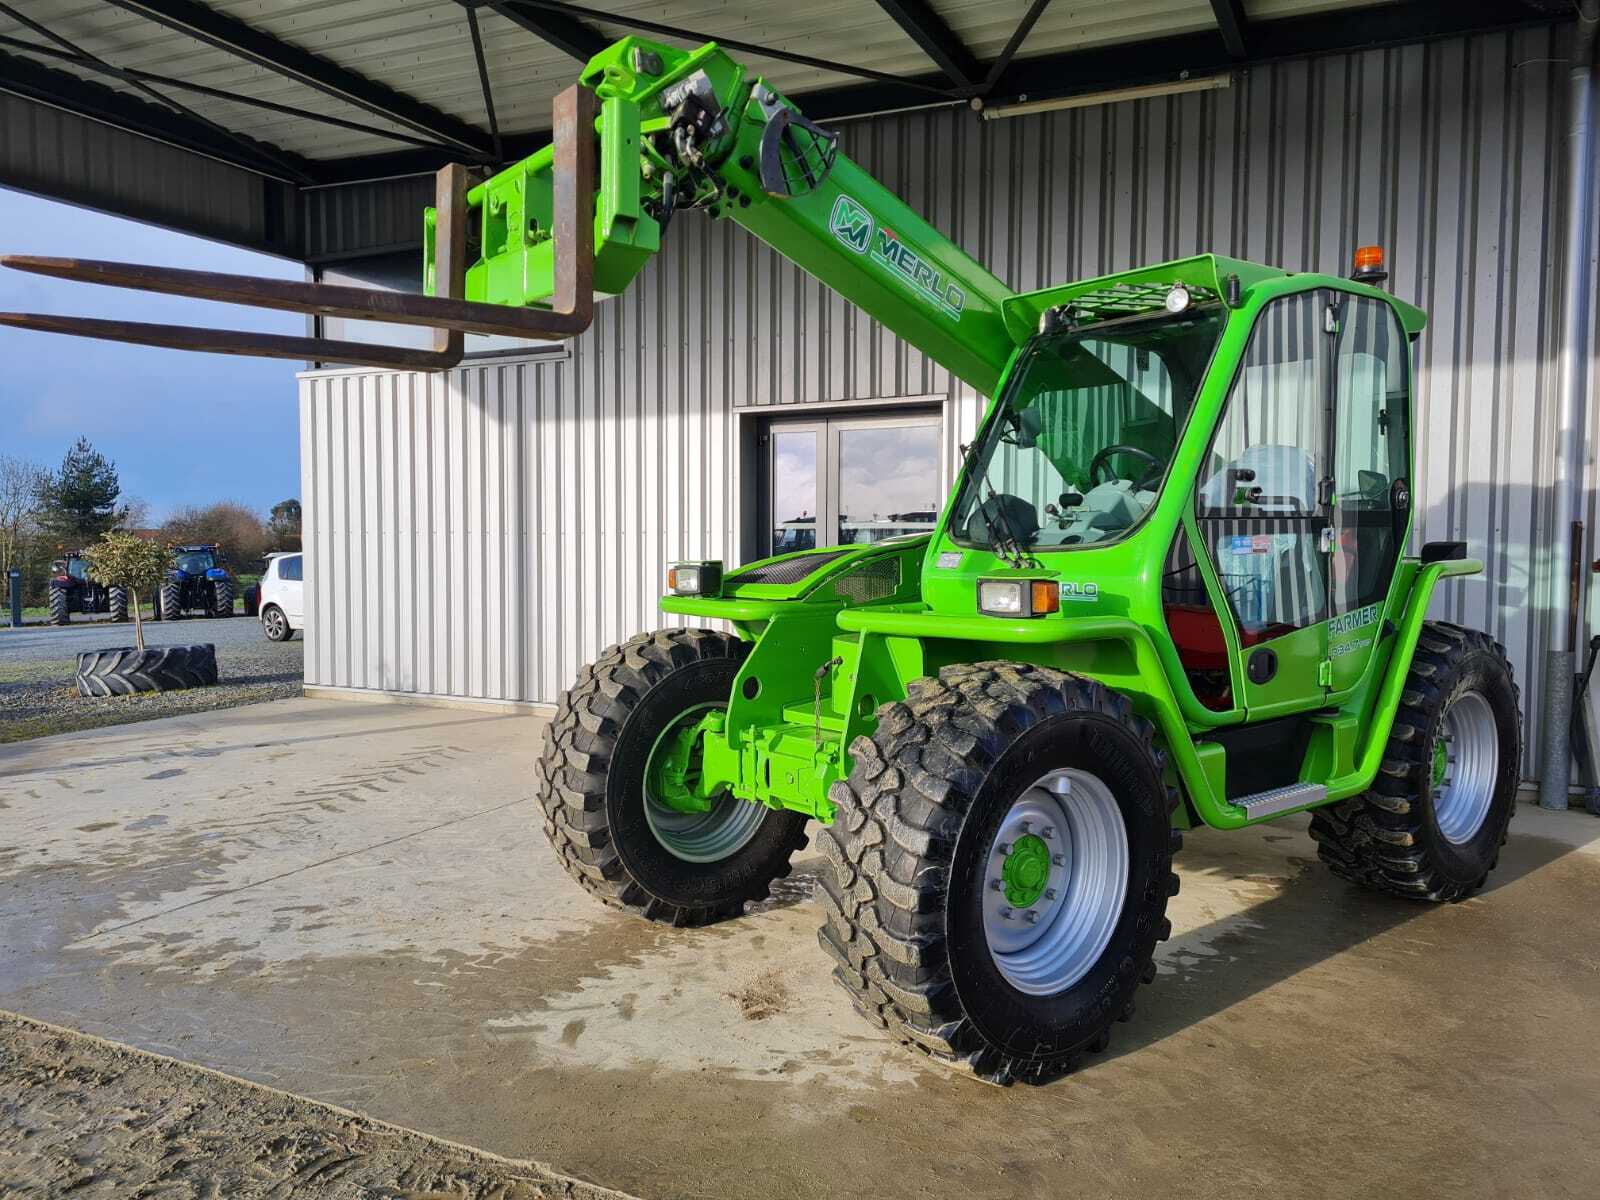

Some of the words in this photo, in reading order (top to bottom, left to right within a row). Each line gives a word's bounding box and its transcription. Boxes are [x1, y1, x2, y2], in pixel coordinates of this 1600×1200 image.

[877, 227, 966, 313] MERLO
[1061, 583, 1098, 596] RLO
[1327, 606, 1378, 635] FARMER
